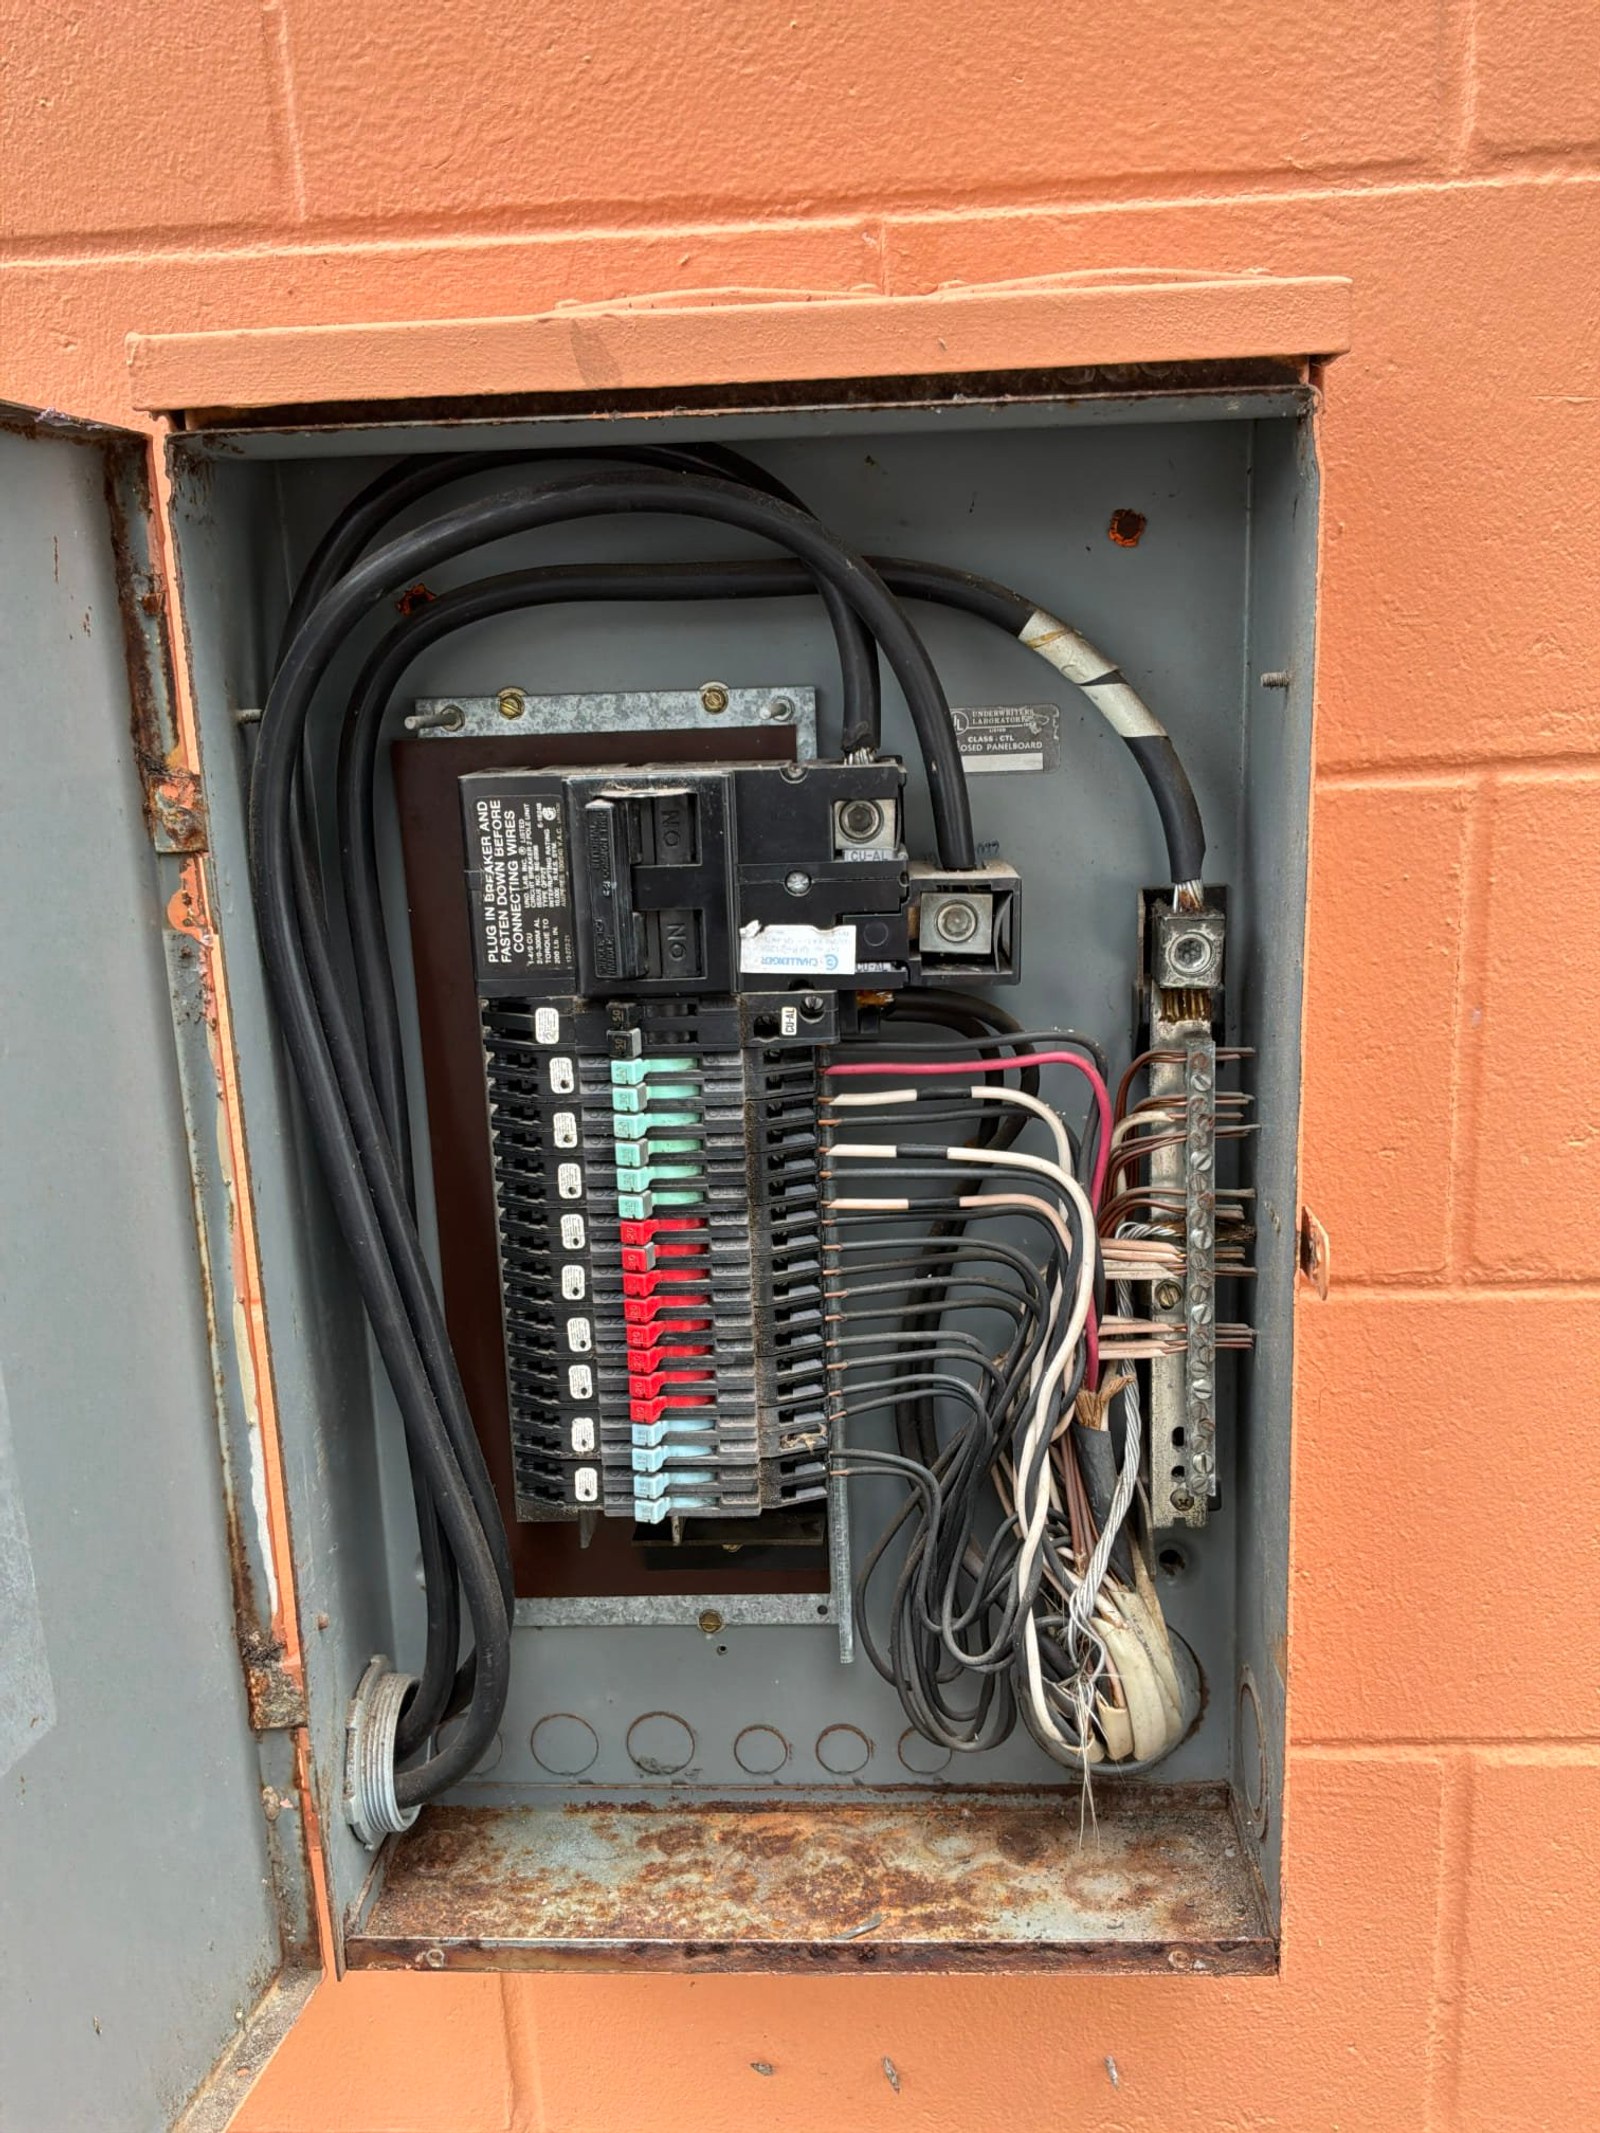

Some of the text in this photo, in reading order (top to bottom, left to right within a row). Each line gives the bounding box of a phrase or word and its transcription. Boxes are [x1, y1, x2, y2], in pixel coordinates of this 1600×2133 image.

[986, 742, 1043, 751] PANELBOARD
[523, 803, 531, 820] UNIT
[662, 810, 681, 847] ON
[850, 851, 889, 860] CU-AL
[477, 801, 499, 963] PLUG IN BREAKER AND
[490, 800, 512, 963] FASTEN DOWN BEFORE
[504, 810, 524, 953] CONNECTING WIRES
[542, 919, 551, 964] TORQUE TO
[667, 924, 687, 962] ON
[760, 956, 818, 967] CHALLENGER
[785, 1009, 796, 1033] CU-AL
